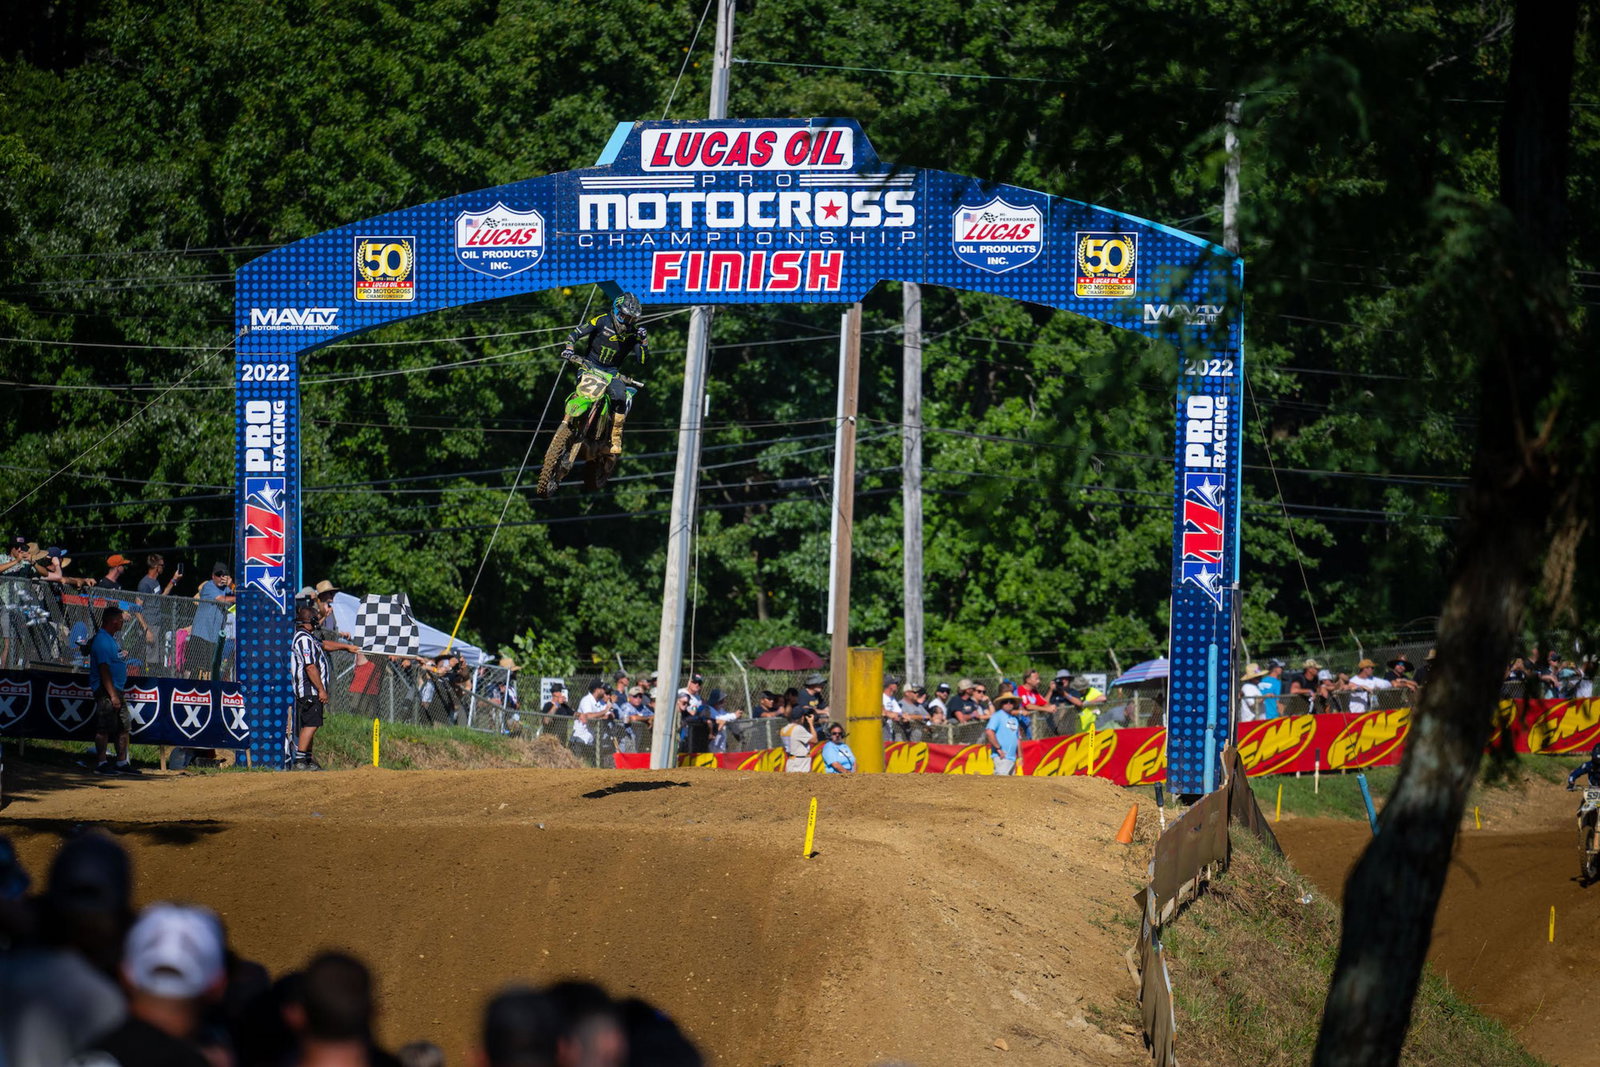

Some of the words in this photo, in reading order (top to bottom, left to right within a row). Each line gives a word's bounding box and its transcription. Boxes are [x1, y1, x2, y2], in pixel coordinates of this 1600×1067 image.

[650, 130, 778, 168] LUCAS
[784, 130, 845, 166] OIL
[702, 174, 792, 188] PRO
[579, 191, 916, 230] MOTOCROSS
[465, 228, 537, 246] LUCAS
[578, 232, 916, 247] CHAMPIONSHIP
[963, 223, 1035, 240] LUCAS
[364, 243, 408, 277] 50
[461, 251, 480, 260] OIL
[482, 250, 539, 259] PRODUCTS
[958, 245, 977, 254] OIL
[979, 244, 1037, 254] PRODUCTS
[1086, 238, 1130, 274] 50
[490, 261, 512, 270] INC.
[651, 250, 844, 293] FINISH
[987, 256, 1009, 265] INC.
[242, 364, 290, 382] 2022
[1184, 358, 1234, 377] 2022
[245, 400, 271, 472] PRO
[273, 400, 286, 472] RACING
[1185, 395, 1214, 468] PRO
[1213, 395, 1228, 468] RACING
[51, 689, 94, 697] RACER
[175, 695, 209, 703] RACER
[59, 699, 83, 721] X
[181, 705, 202, 728] X
[230, 708, 249, 730] X
[1239, 714, 1314, 770] FMF
[1330, 708, 1411, 769] FMF
